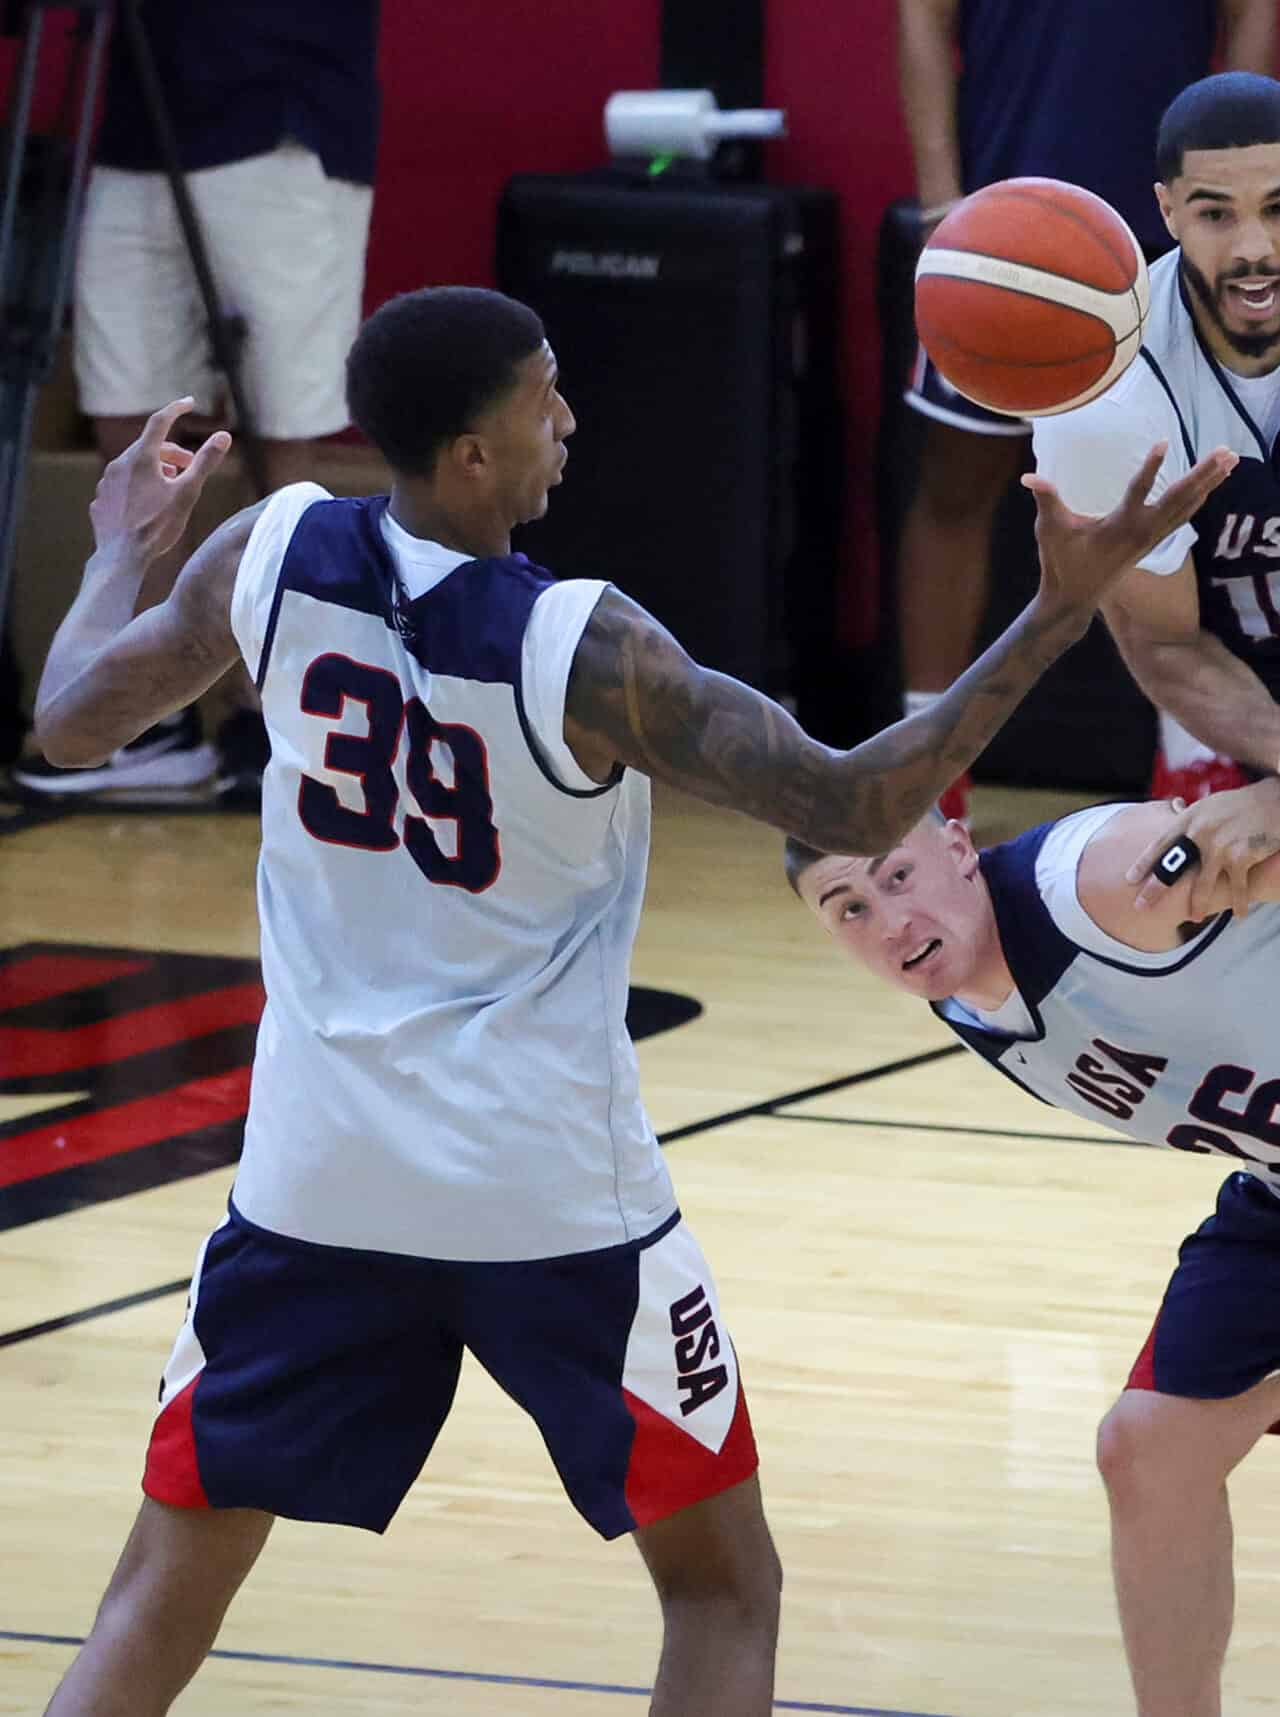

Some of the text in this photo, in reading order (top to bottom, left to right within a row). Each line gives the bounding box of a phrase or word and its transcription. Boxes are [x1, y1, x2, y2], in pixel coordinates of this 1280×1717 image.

[297, 651, 502, 896] 39
[1065, 1038, 1169, 1121] USA
[669, 1284, 728, 1417] USA
